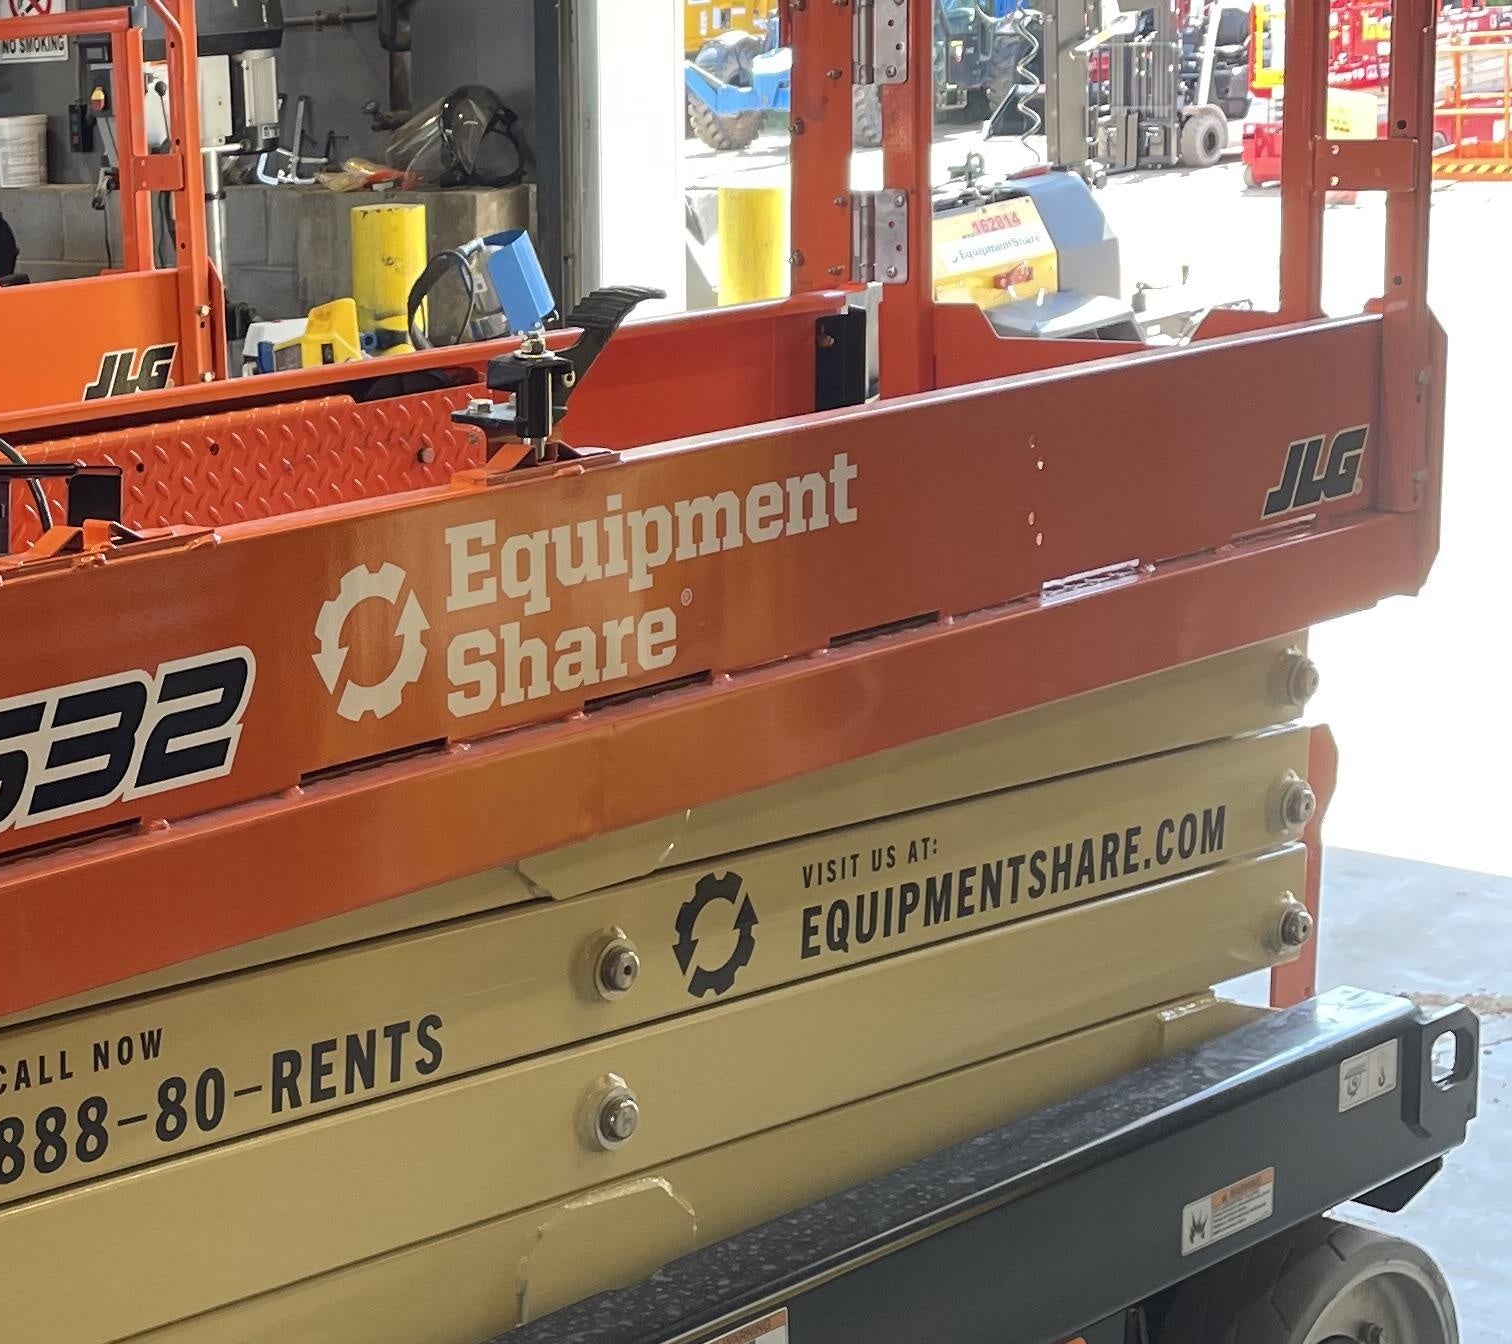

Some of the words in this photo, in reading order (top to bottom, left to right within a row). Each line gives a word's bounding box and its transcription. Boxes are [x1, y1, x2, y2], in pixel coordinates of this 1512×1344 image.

[2, 38, 16, 54] NO
[19, 34, 65, 53] SMOKING
[82, 342, 178, 401] JLG
[1261, 425, 1370, 520] JLG
[445, 453, 858, 617] Equipment
[446, 603, 677, 720] Share
[800, 805, 1226, 961] EQUIPMENTSHARE.COM
[802, 853, 858, 889] VISIT
[872, 845, 896, 872] US
[908, 837, 938, 865] AT:
[93, 1028, 164, 1073] NOW
